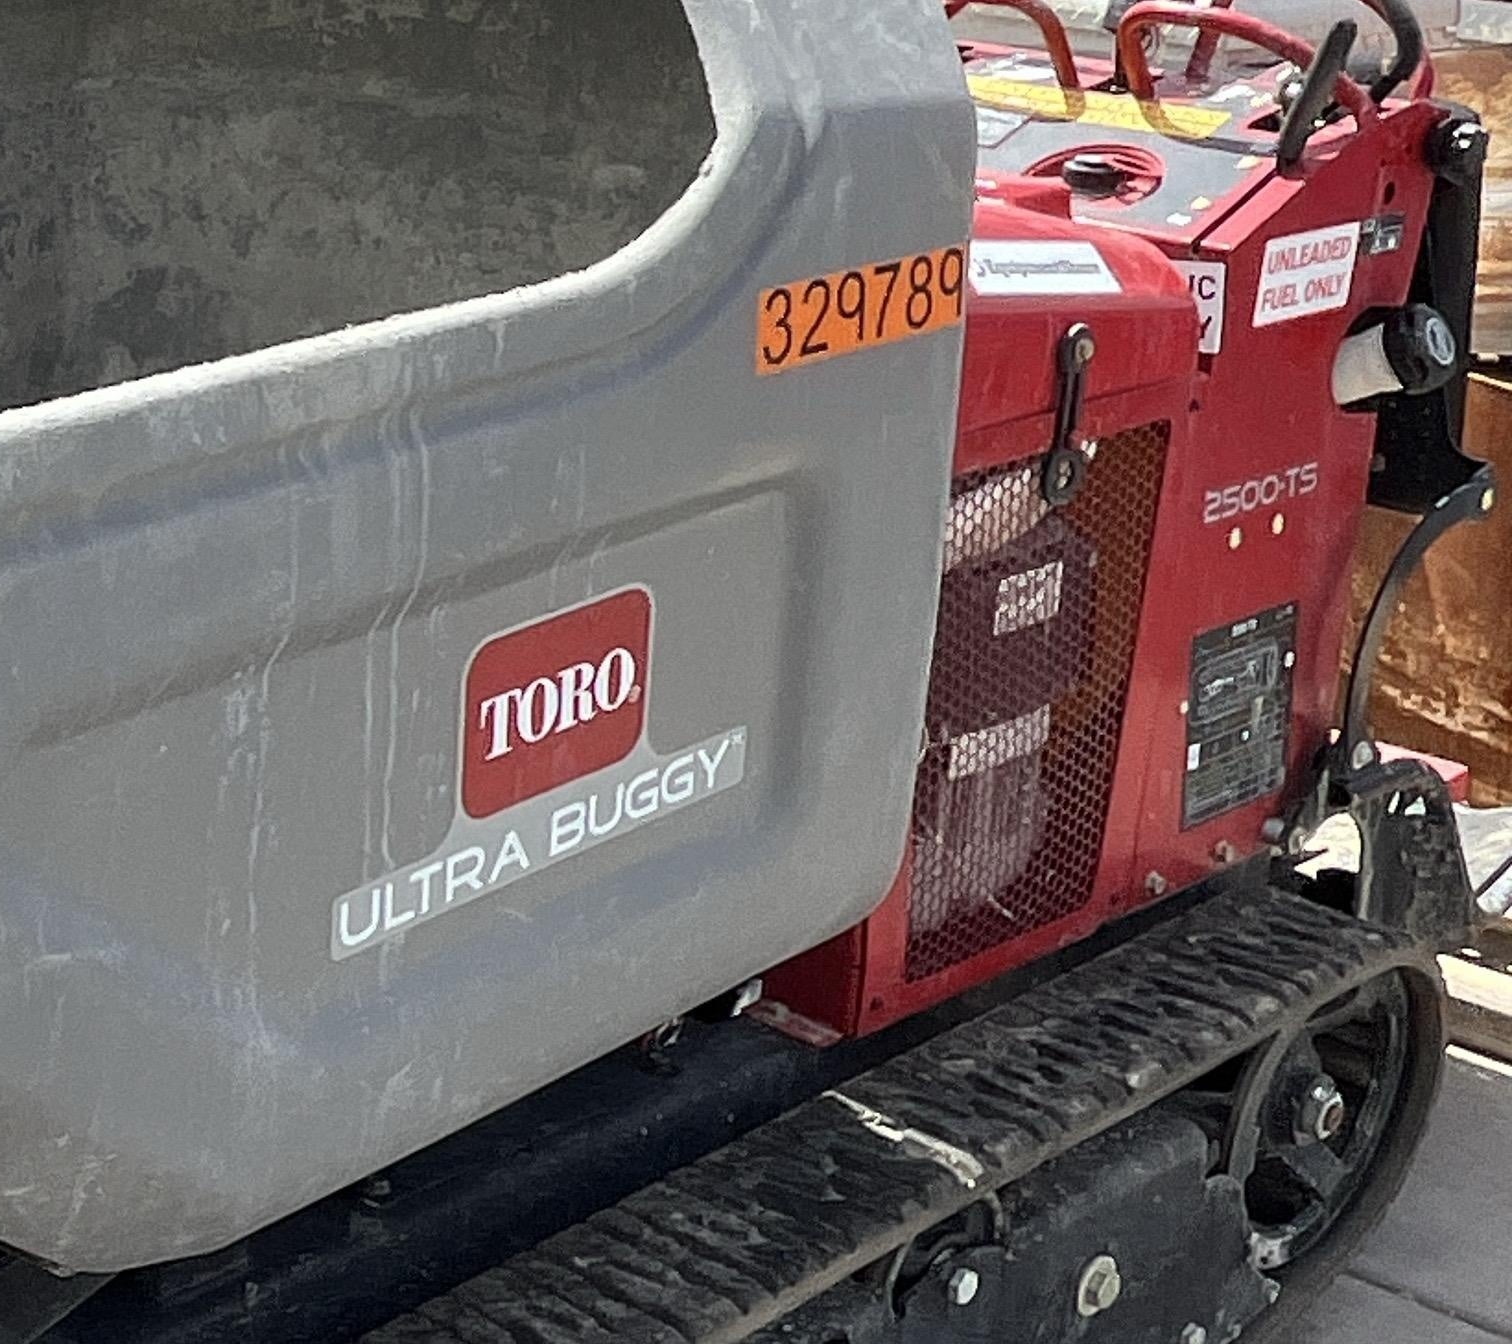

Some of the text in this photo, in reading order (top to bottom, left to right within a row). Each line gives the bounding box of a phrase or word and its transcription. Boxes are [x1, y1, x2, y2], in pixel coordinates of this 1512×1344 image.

[1261, 271, 1347, 313] FUEL ONLY
[1267, 235, 1353, 275] UNLEADED
[762, 247, 965, 366] 329789
[338, 739, 730, 947] ULTRA BUGGY
